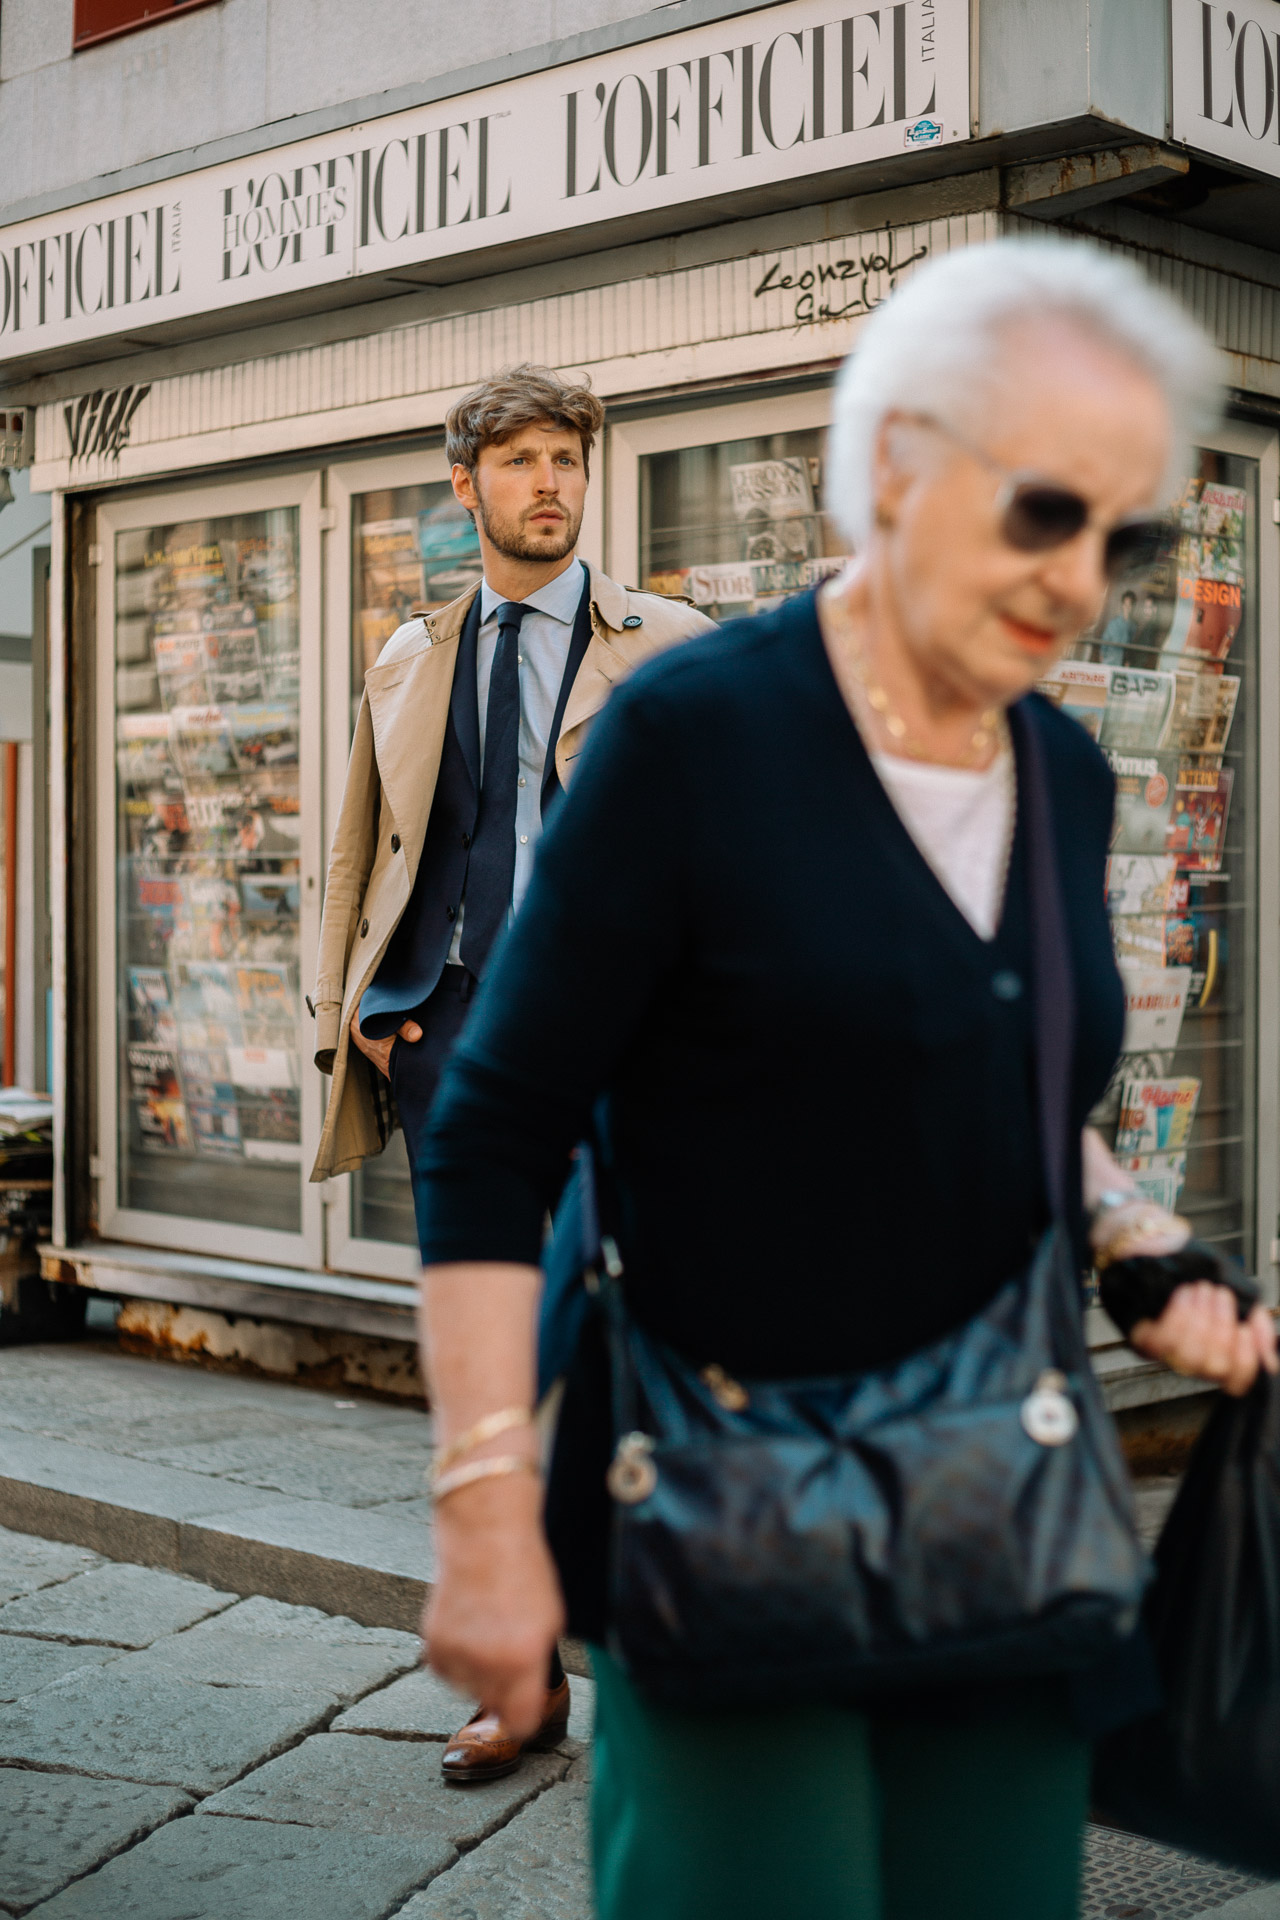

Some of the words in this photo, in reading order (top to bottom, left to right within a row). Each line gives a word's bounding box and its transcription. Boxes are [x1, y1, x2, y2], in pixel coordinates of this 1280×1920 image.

[921, 0, 935, 62] ITALIA
[560, 1, 936, 200] L'OFFICIEL
[1197, 0, 1280, 146] L'O
[171, 201, 182, 253] ITALIA
[223, 184, 347, 250] HOMMES
[1180, 577, 1242, 609] DESIGN
